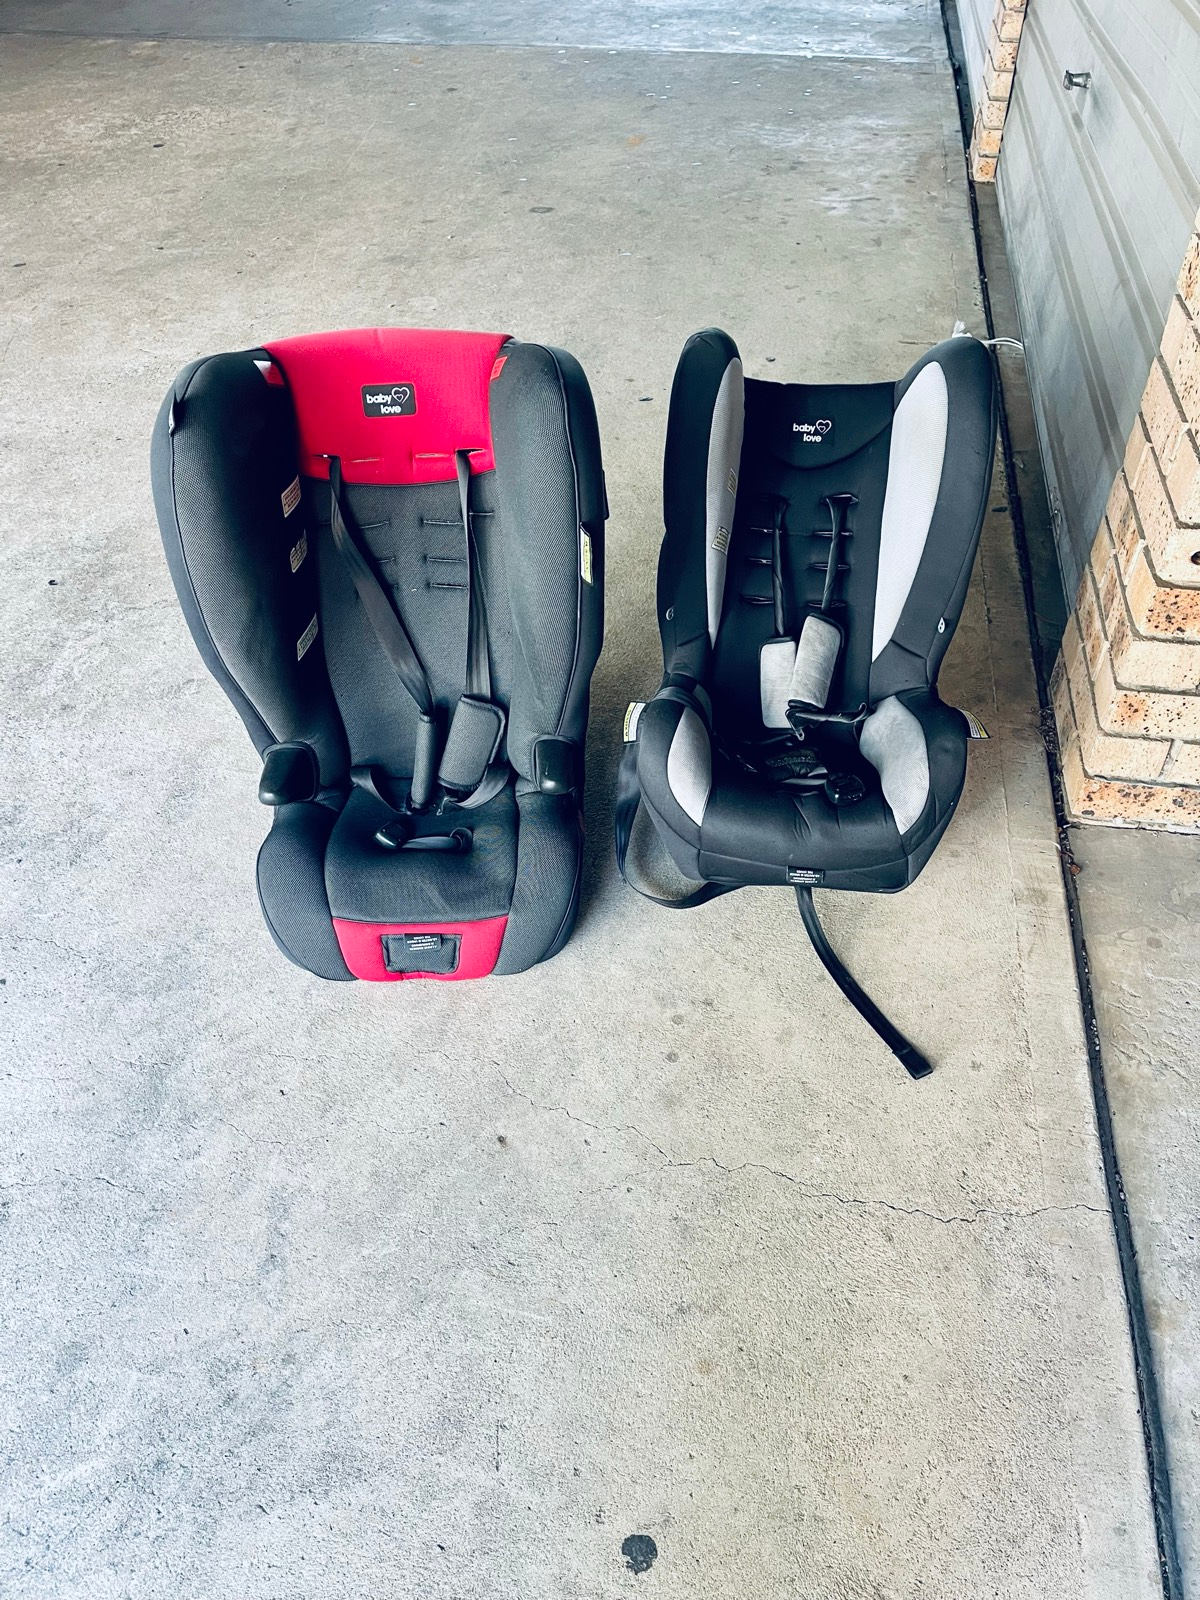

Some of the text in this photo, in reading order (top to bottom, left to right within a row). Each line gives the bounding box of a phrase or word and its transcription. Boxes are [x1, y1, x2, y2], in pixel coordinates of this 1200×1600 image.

[366, 393, 391, 404] baby
[381, 404, 401, 414] love
[793, 422, 815, 433] baby
[803, 433, 822, 442] love
